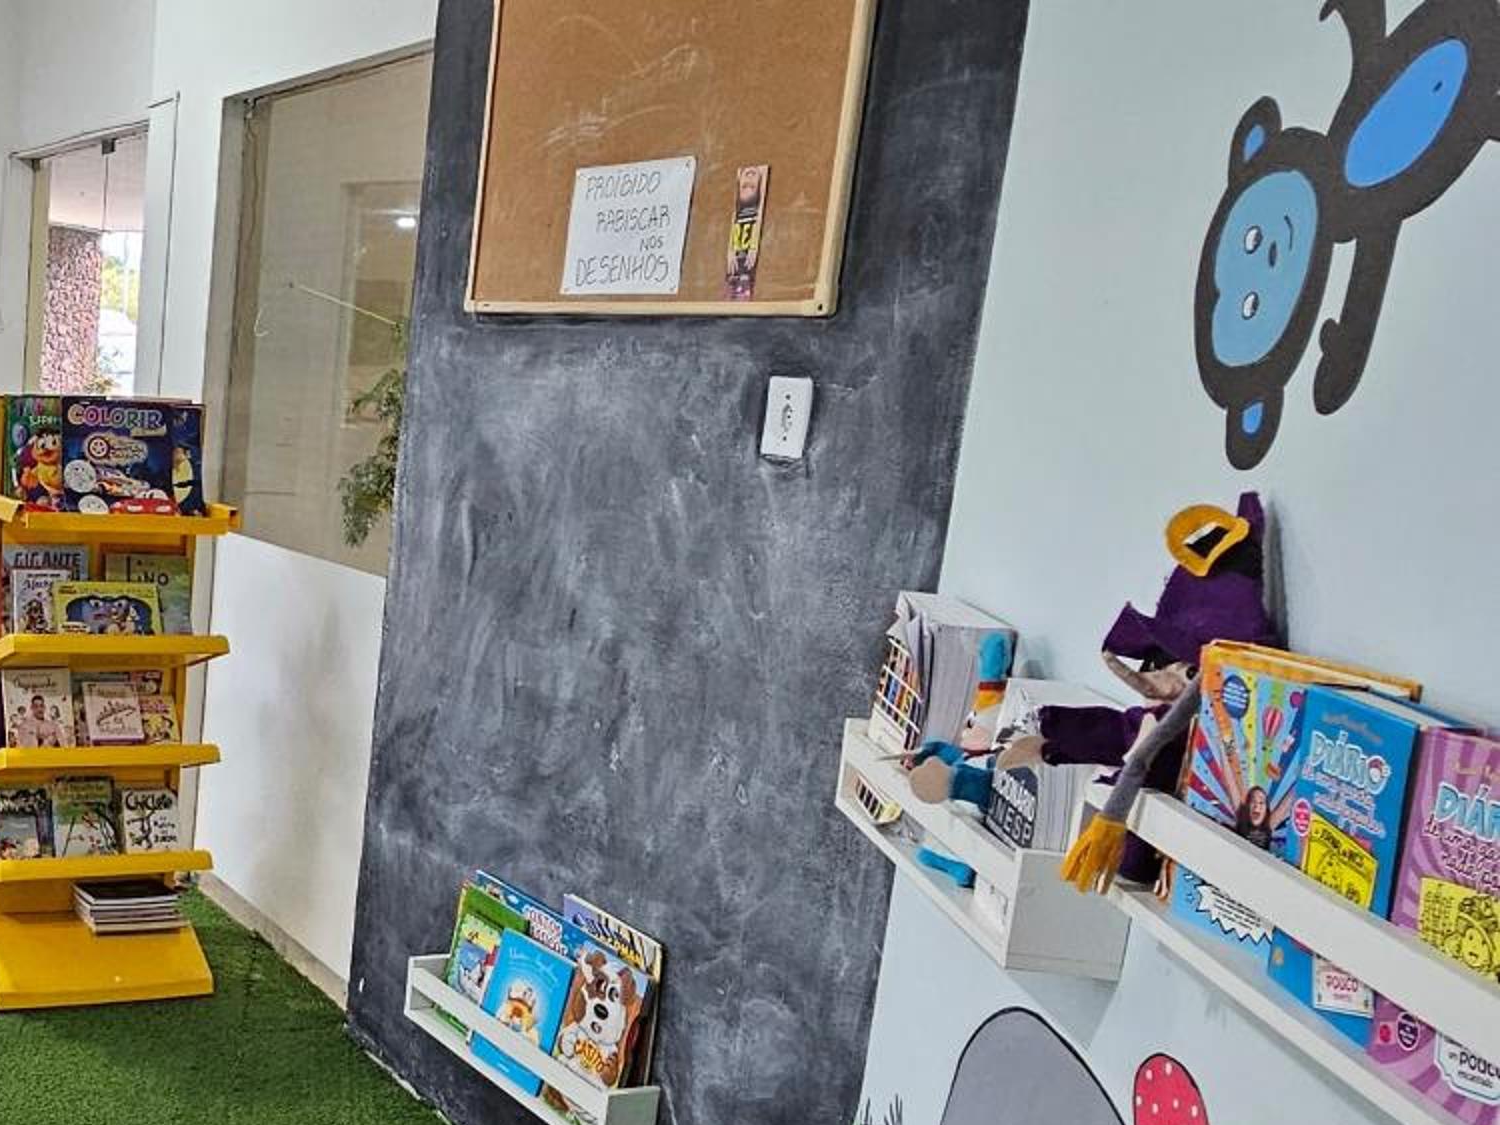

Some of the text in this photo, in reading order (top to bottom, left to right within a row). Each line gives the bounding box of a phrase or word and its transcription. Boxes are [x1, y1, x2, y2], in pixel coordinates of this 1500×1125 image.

[585, 171, 661, 200] PROIBIDO
[595, 205, 671, 232] RABISCAR
[640, 235, 665, 251] NOS
[576, 253, 669, 286] DESENHOS
[68, 404, 163, 429] COLORIR
[14, 551, 81, 570] GIGANTE
